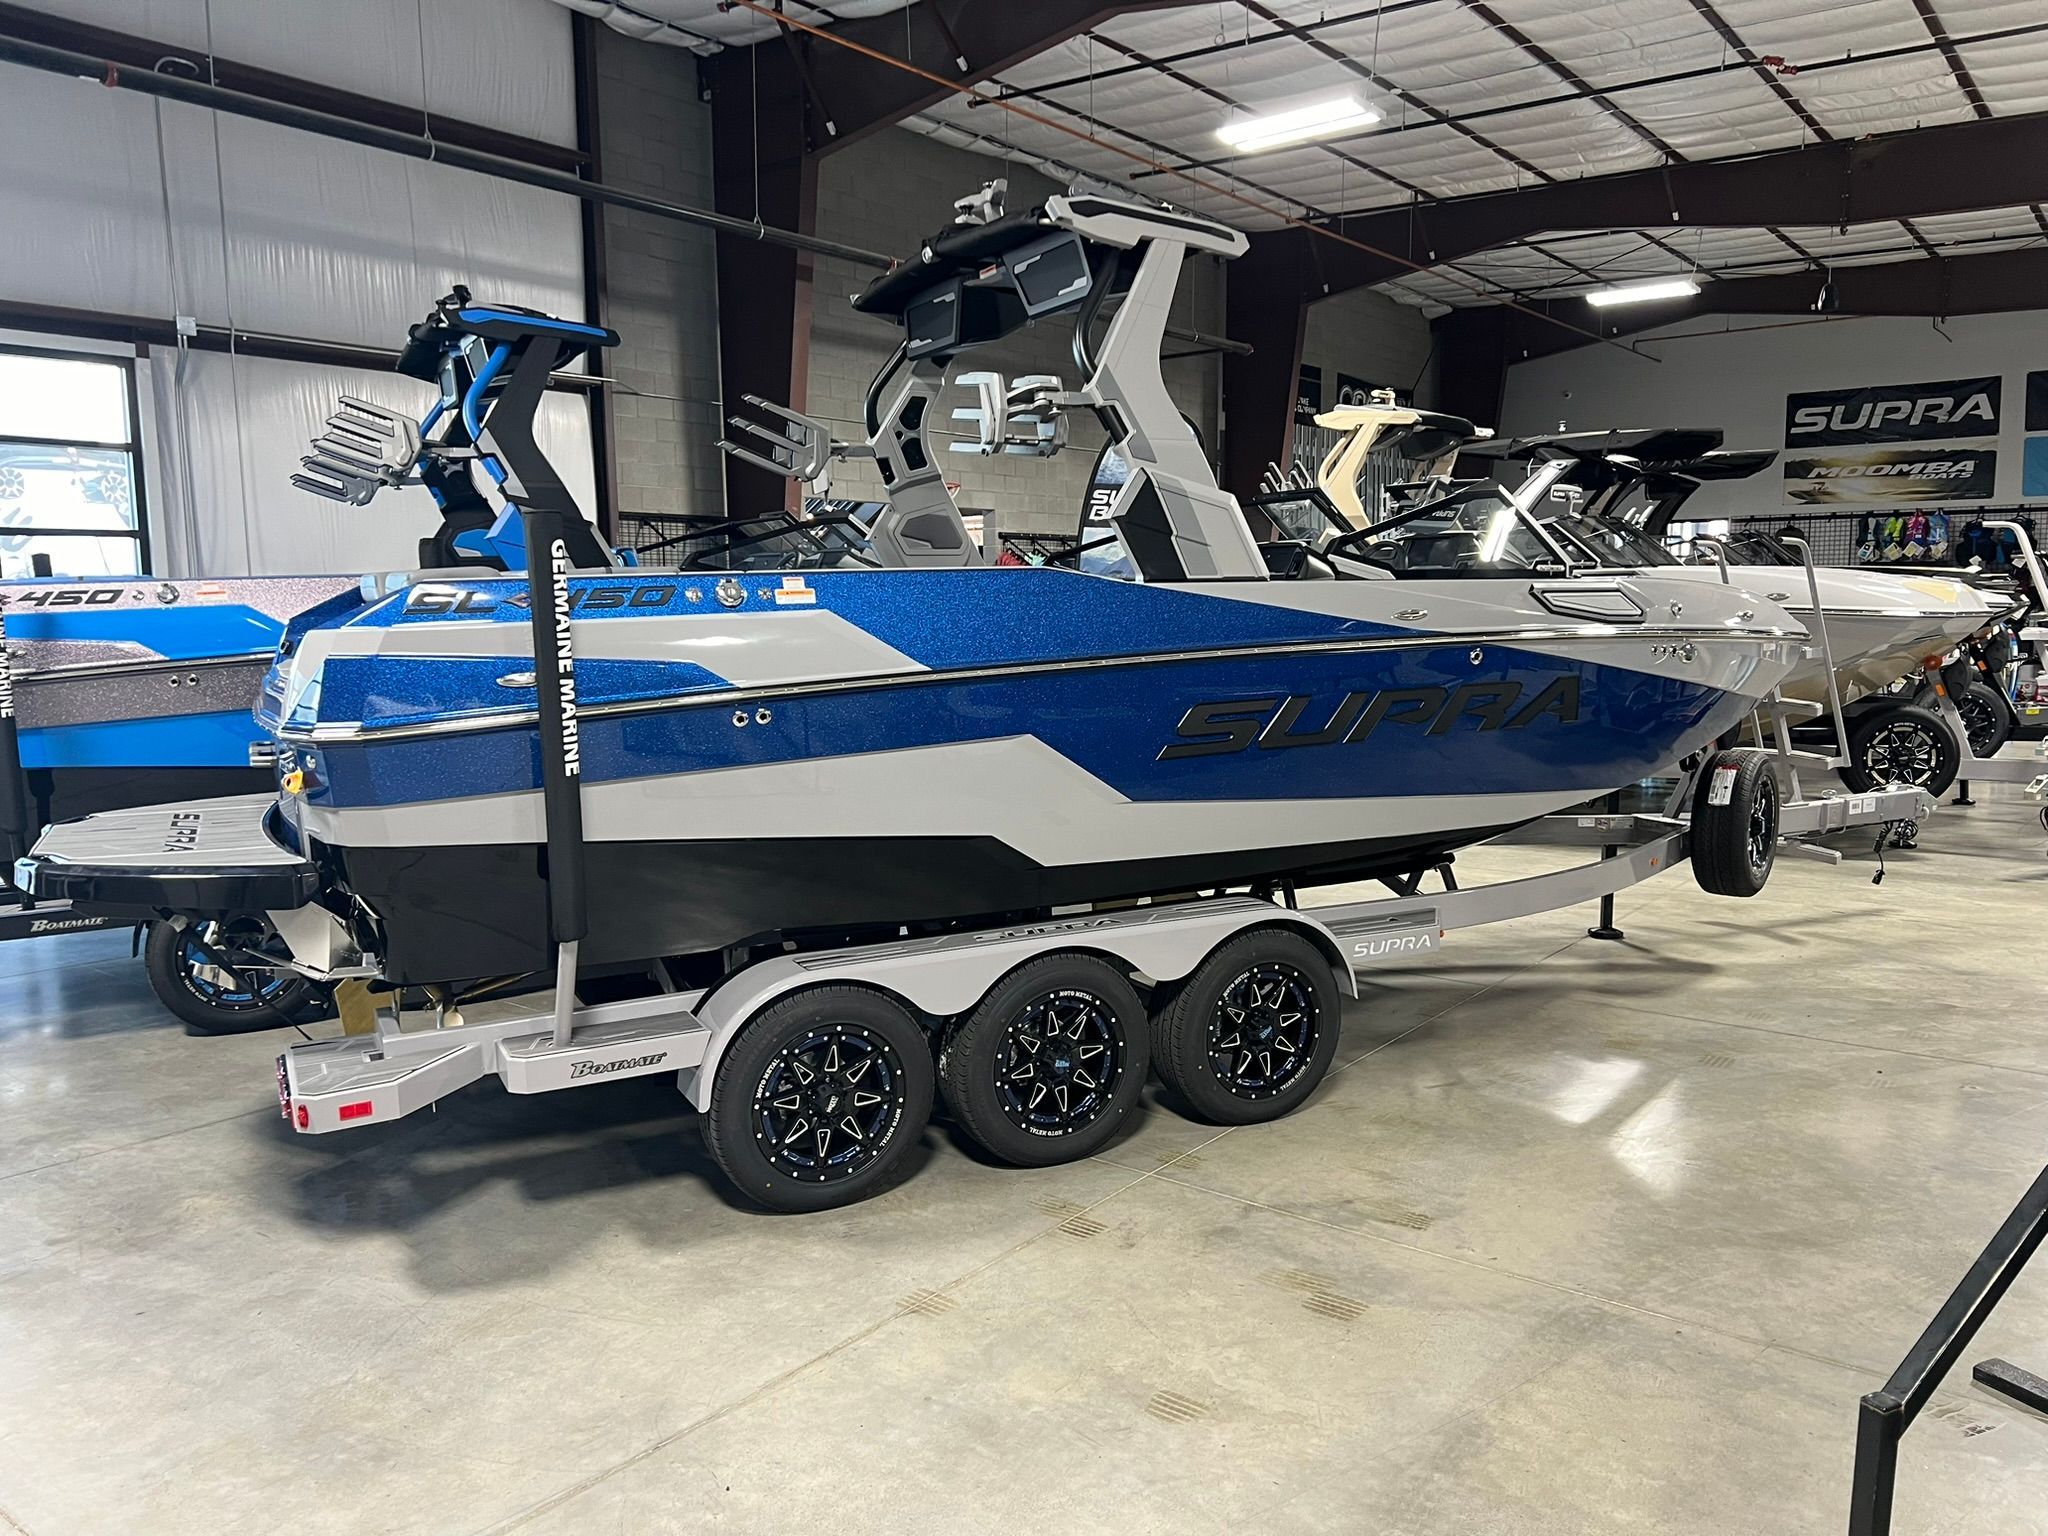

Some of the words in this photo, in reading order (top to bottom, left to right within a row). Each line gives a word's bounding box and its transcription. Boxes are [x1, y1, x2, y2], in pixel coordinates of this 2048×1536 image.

[1790, 393, 1995, 434] SUPRA
[1807, 460, 1975, 478] MOOMBA
[1908, 472, 1973, 480] BOATS
[16, 588, 125, 606] 450
[403, 591, 497, 614] SL
[550, 538, 573, 674] GERMAINE
[559, 678, 581, 777] MARINE
[1156, 675, 1580, 761] SUPRA
[1353, 934, 1431, 957] SUPRA
[755, 1079, 767, 1099] MOTO
[764, 1058, 780, 1079] METAL
